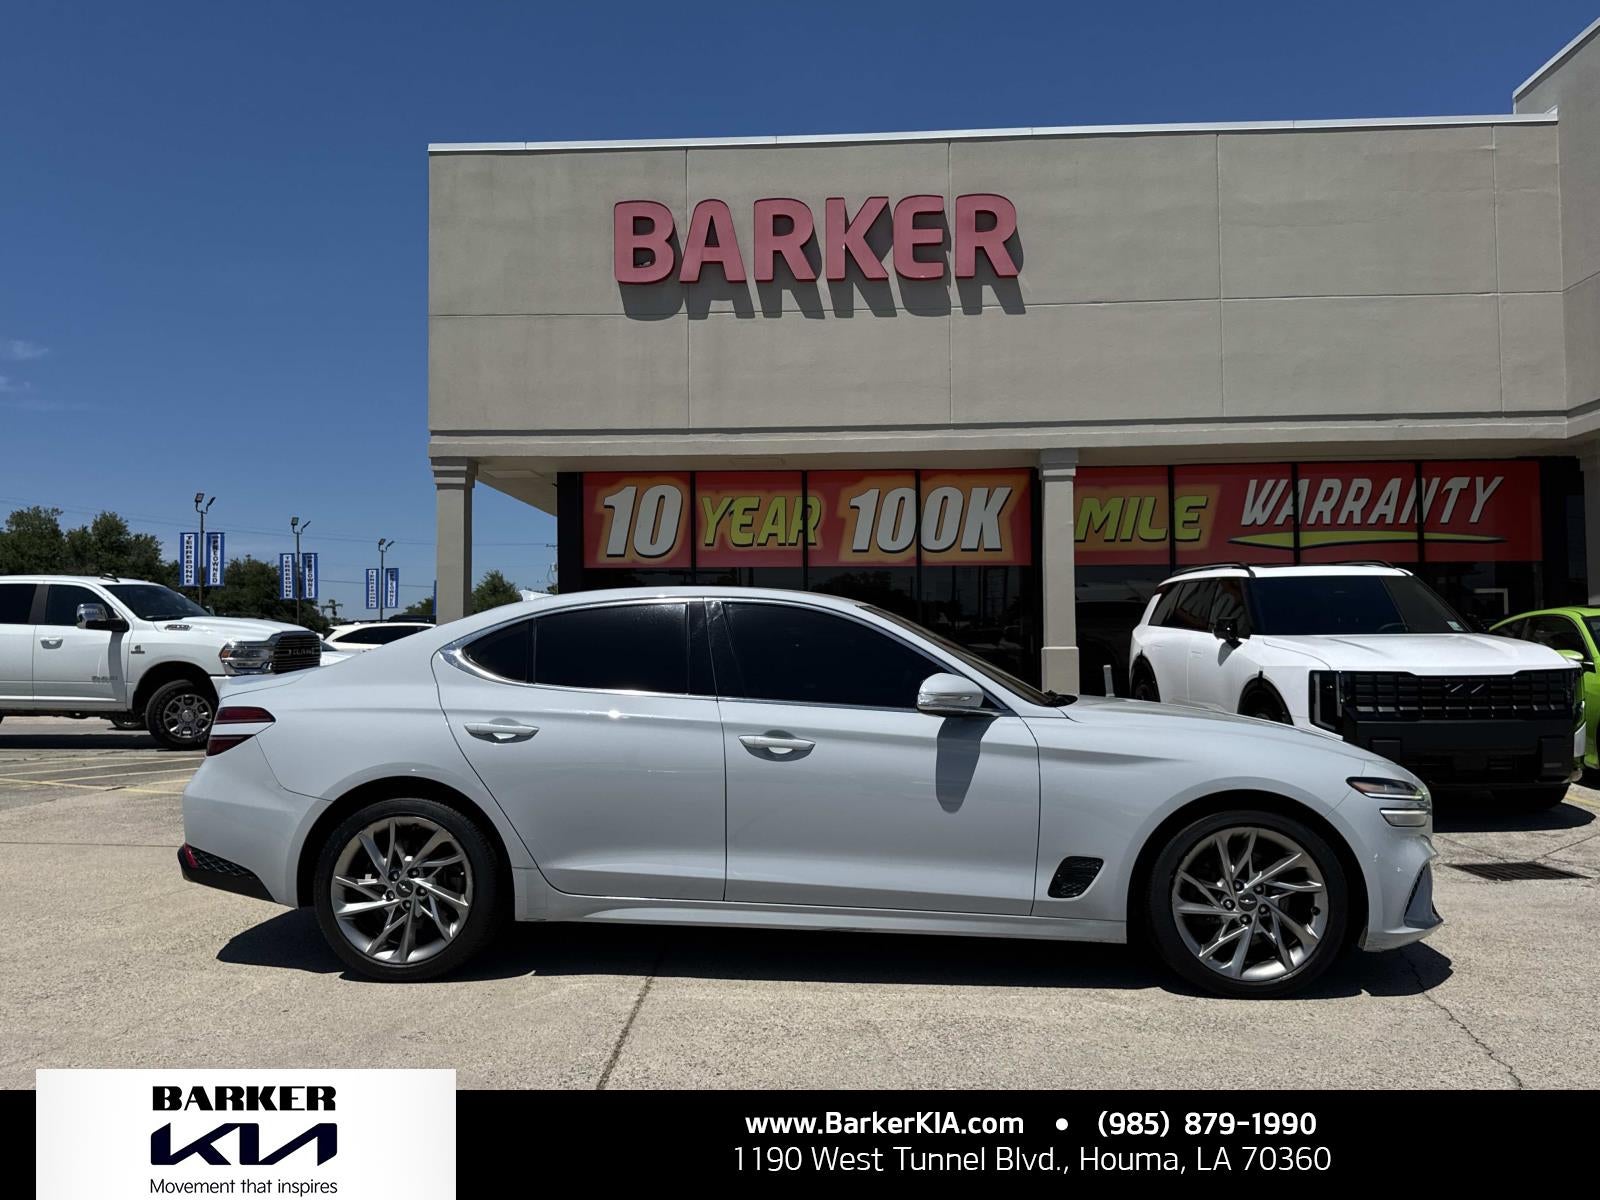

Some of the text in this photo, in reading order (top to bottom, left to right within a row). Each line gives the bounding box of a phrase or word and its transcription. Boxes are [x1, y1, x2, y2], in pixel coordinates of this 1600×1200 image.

[614, 193, 1019, 283] BARKER
[603, 475, 1505, 558] 10 YEAR 100K MILE WARRANTY
